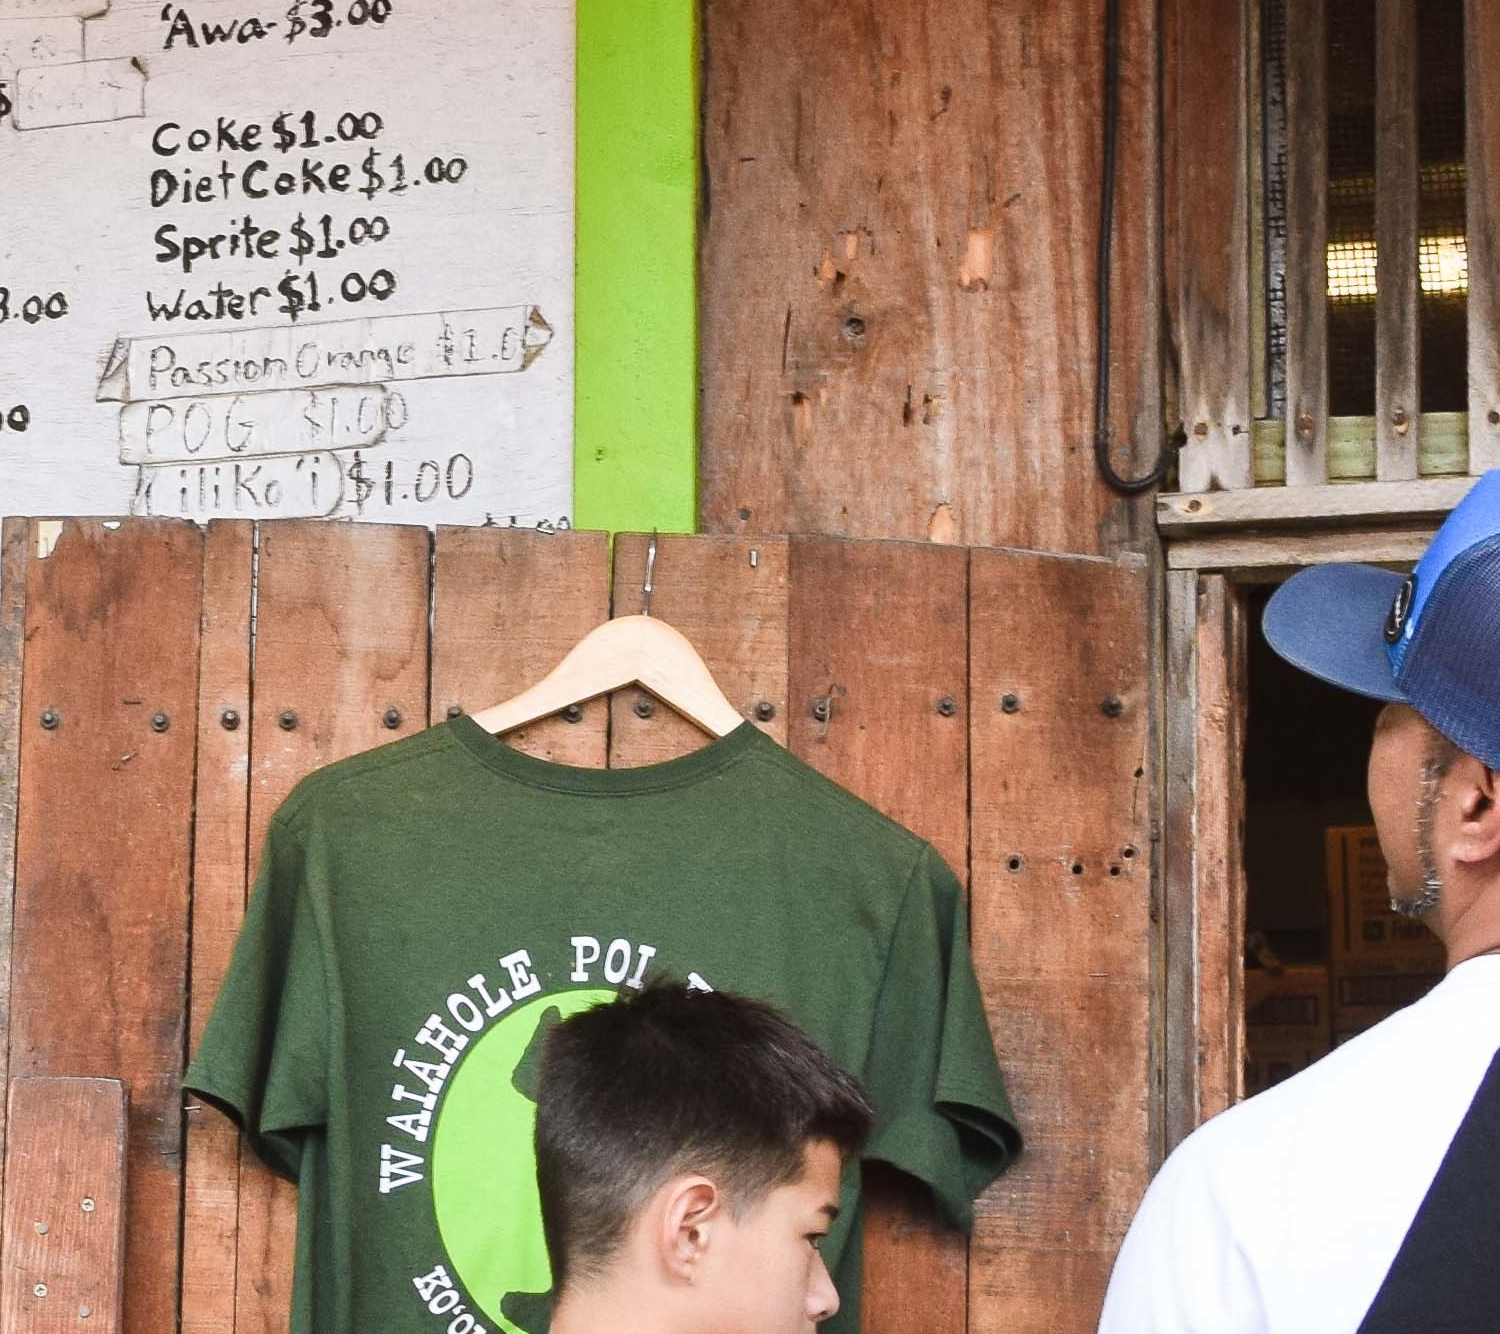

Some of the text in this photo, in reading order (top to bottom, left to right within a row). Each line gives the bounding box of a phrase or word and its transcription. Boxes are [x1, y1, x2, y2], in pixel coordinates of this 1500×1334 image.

[151, 110, 384, 160] Coke $1.00
[150, 146, 468, 208] Diet Coke $1.00
[154, 211, 390, 274] Sprite $1.00
[146, 268, 397, 323] Water $1.00
[148, 341, 415, 390] Passion Orange
[146, 399, 255, 453] POG
[346, 450, 474, 515] $1.00
[570, 936, 656, 989] POI
